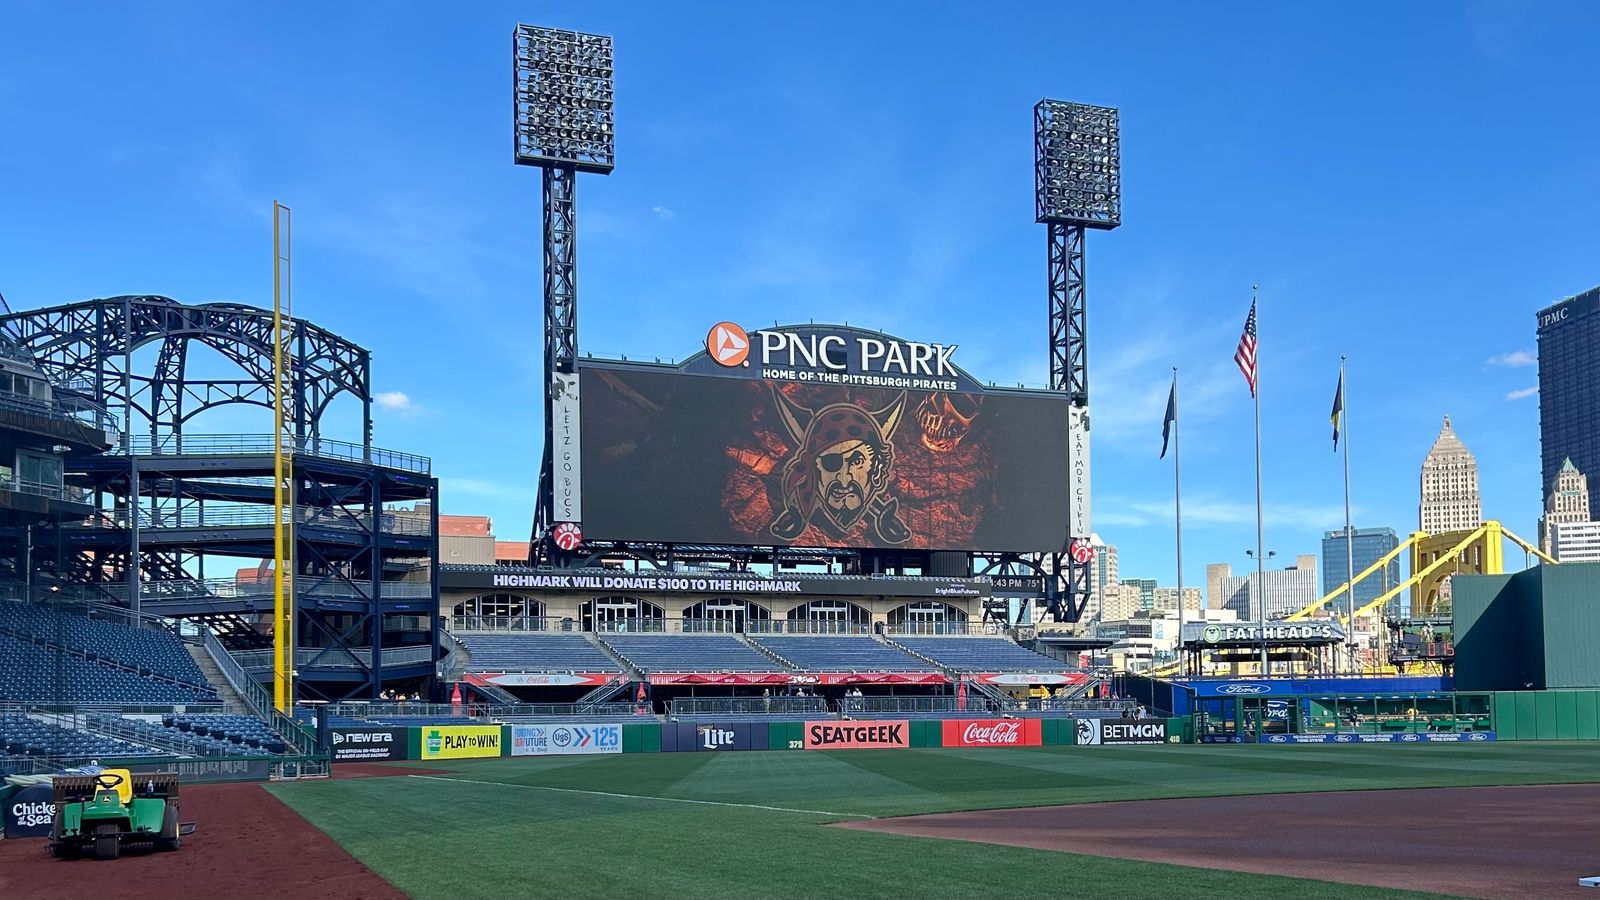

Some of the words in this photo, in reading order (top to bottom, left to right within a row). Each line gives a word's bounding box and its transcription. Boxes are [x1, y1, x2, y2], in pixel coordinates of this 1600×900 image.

[1537, 308, 1568, 328] UPMC
[757, 330, 846, 370] PNC
[856, 338, 959, 377] PARK
[763, 369, 796, 380] HOME
[799, 371, 814, 382] OF
[817, 372, 839, 383] THE
[843, 374, 910, 388] PITTSBURGH
[913, 379, 957, 391] PIRATES
[564, 406, 572, 445] LETZ
[564, 452, 572, 472] GO
[1075, 460, 1084, 484] MOR
[564, 478, 572, 518] BUCS
[1076, 488, 1084, 534] CHIKIN
[493, 575, 570, 587] HIGHMARK
[572, 576, 602, 588] WILL
[604, 577, 656, 589] DONATE
[658, 578, 689, 590] $100
[690, 579, 706, 590] TO
[708, 579, 732, 591] THE
[734, 580, 801, 592] HIGHMARK
[1226, 627, 1257, 640] FAT
[1263, 626, 1332, 639] HEAD'S
[1226, 684, 1261, 693] Ford
[592, 727, 618, 747] 125
[704, 729, 735, 749] Lite
[810, 724, 903, 745] SEATGEEK
[963, 722, 1021, 744] Coca-Cola
[1103, 724, 1164, 738] BETMGM
[1169, 735, 1180, 743] 410
[445, 735, 467, 749] PLAY
[477, 735, 498, 747] WIN!
[13, 802, 56, 816] Chicke
[27, 814, 52, 827] Sea
